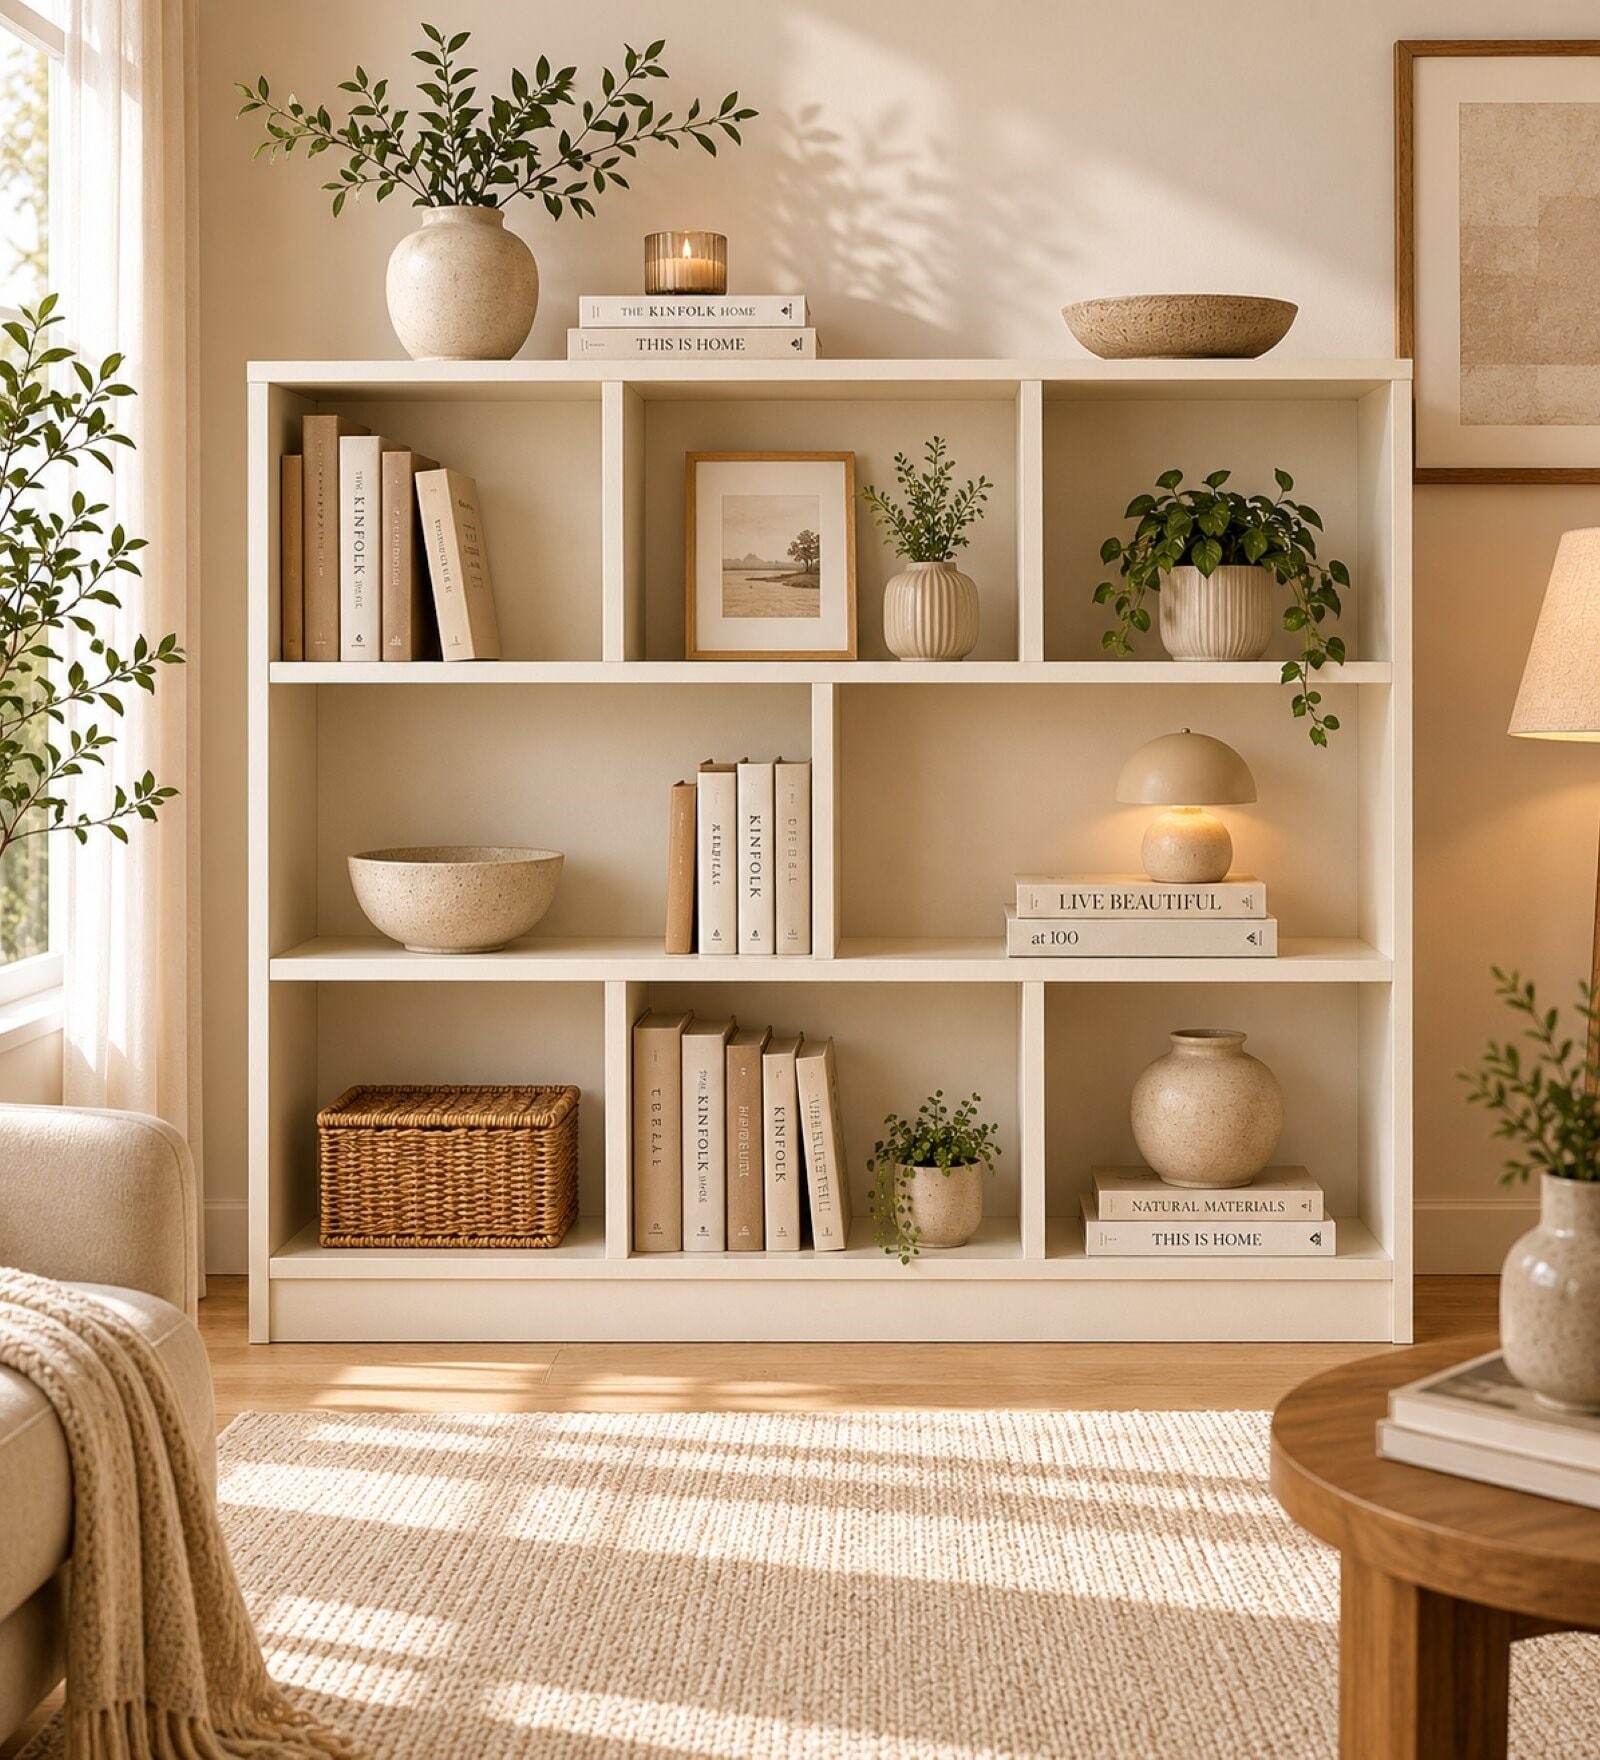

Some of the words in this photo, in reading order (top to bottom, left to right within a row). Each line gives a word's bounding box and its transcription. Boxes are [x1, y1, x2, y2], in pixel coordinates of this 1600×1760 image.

[621, 307, 643, 316] THE
[649, 305, 716, 316] KINFOLK
[720, 307, 756, 316] HOME
[636, 338, 673, 351] THIS
[679, 338, 691, 351] IS
[697, 338, 745, 351] HOME
[354, 496, 365, 575] KINFOLK
[749, 815, 761, 898] KINFOLK
[1059, 893, 1104, 911] LIVE
[1111, 893, 1221, 911] BEAUTIFUL
[1031, 932, 1046, 945] at
[1050, 931, 1079, 945] 100
[698, 1095, 709, 1171] KINFOLK
[1132, 1201, 1200, 1213] NATURAL
[1204, 1201, 1285, 1213] MATERIALS
[1152, 1233, 1190, 1246] THIS
[1195, 1233, 1208, 1246] IS
[1213, 1233, 1262, 1246] HOME
